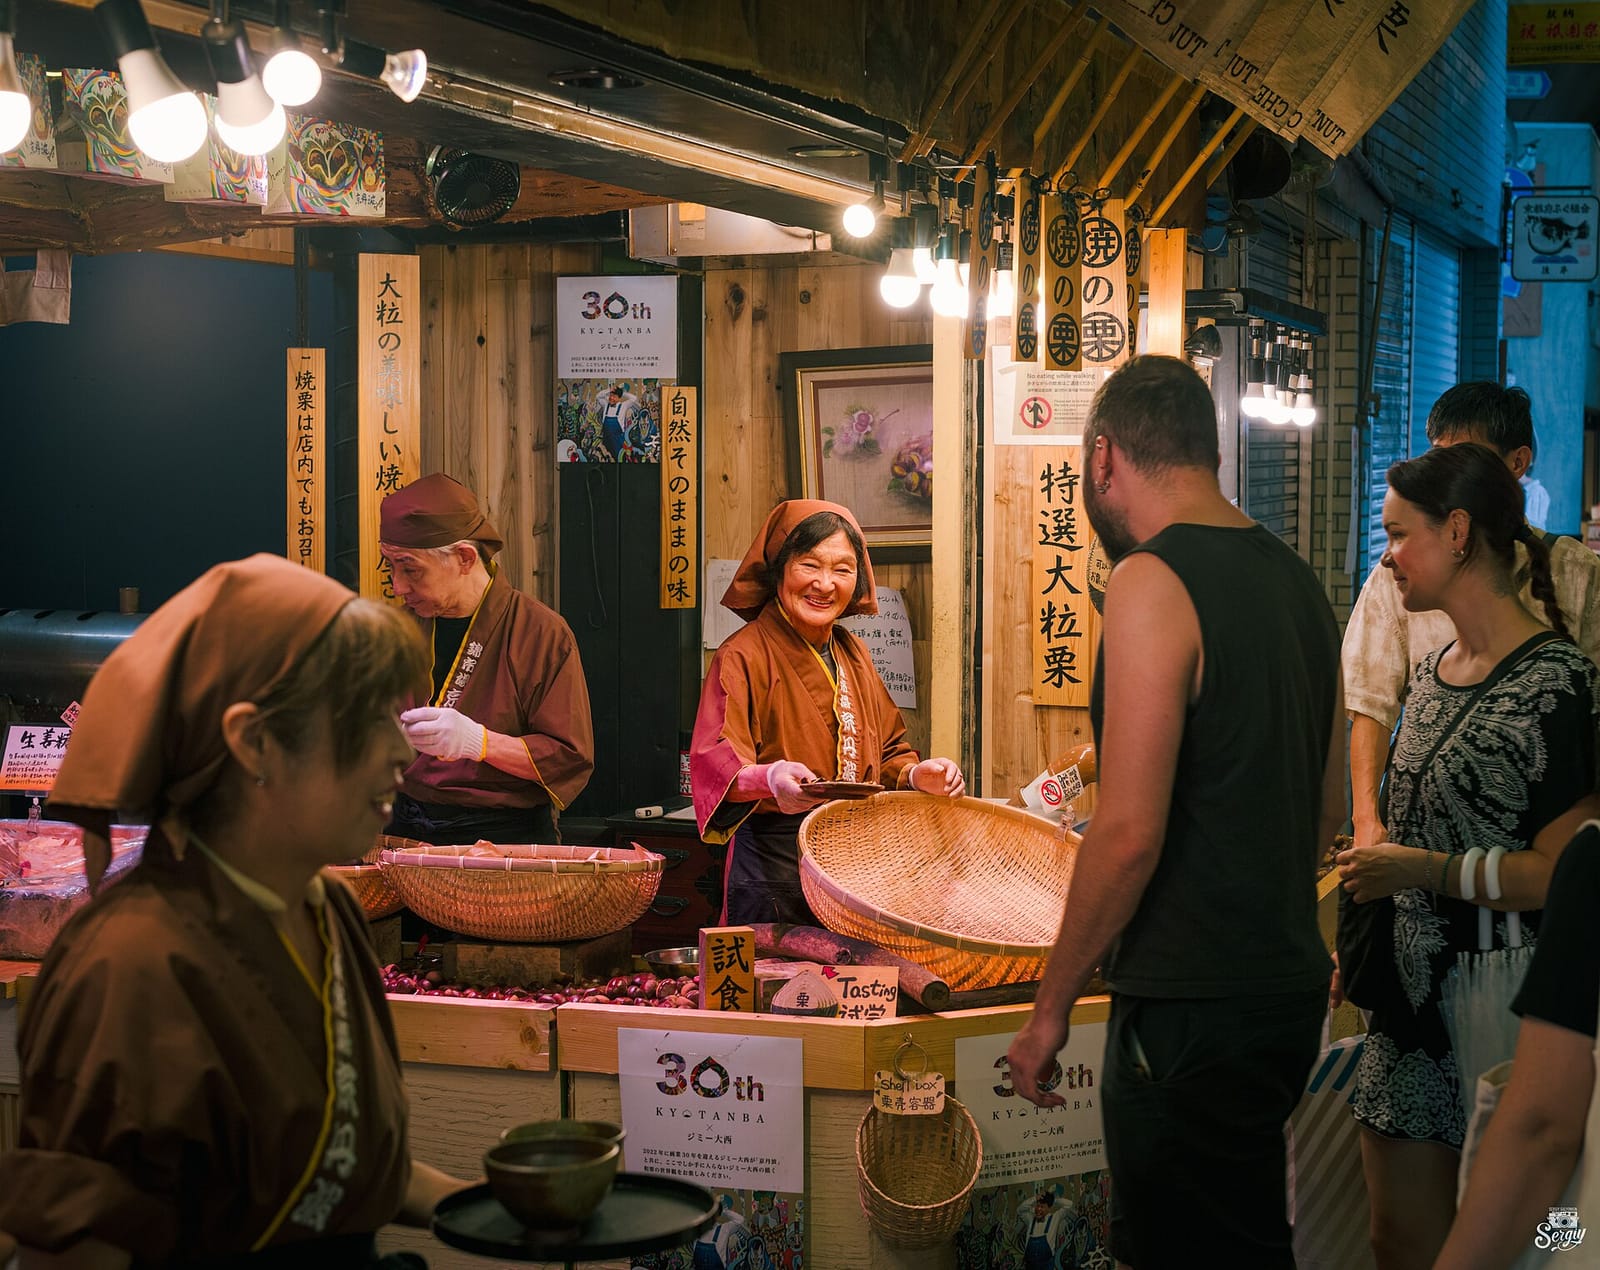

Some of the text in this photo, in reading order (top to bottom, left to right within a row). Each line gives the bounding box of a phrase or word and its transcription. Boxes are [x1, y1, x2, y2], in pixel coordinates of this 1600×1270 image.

[581, 291, 652, 320] 30th
[667, 391, 692, 602] 自然そのままの味
[1038, 461, 1084, 688] 特選大粒栗
[711, 935, 750, 1011] 試食
[796, 992, 810, 1008] 栗
[836, 976, 898, 1002] Tasting
[656, 1052, 765, 1102] 30th
[687, 1132, 733, 1145] ジミー大西
[1022, 1126, 1065, 1139] ジミー大西
